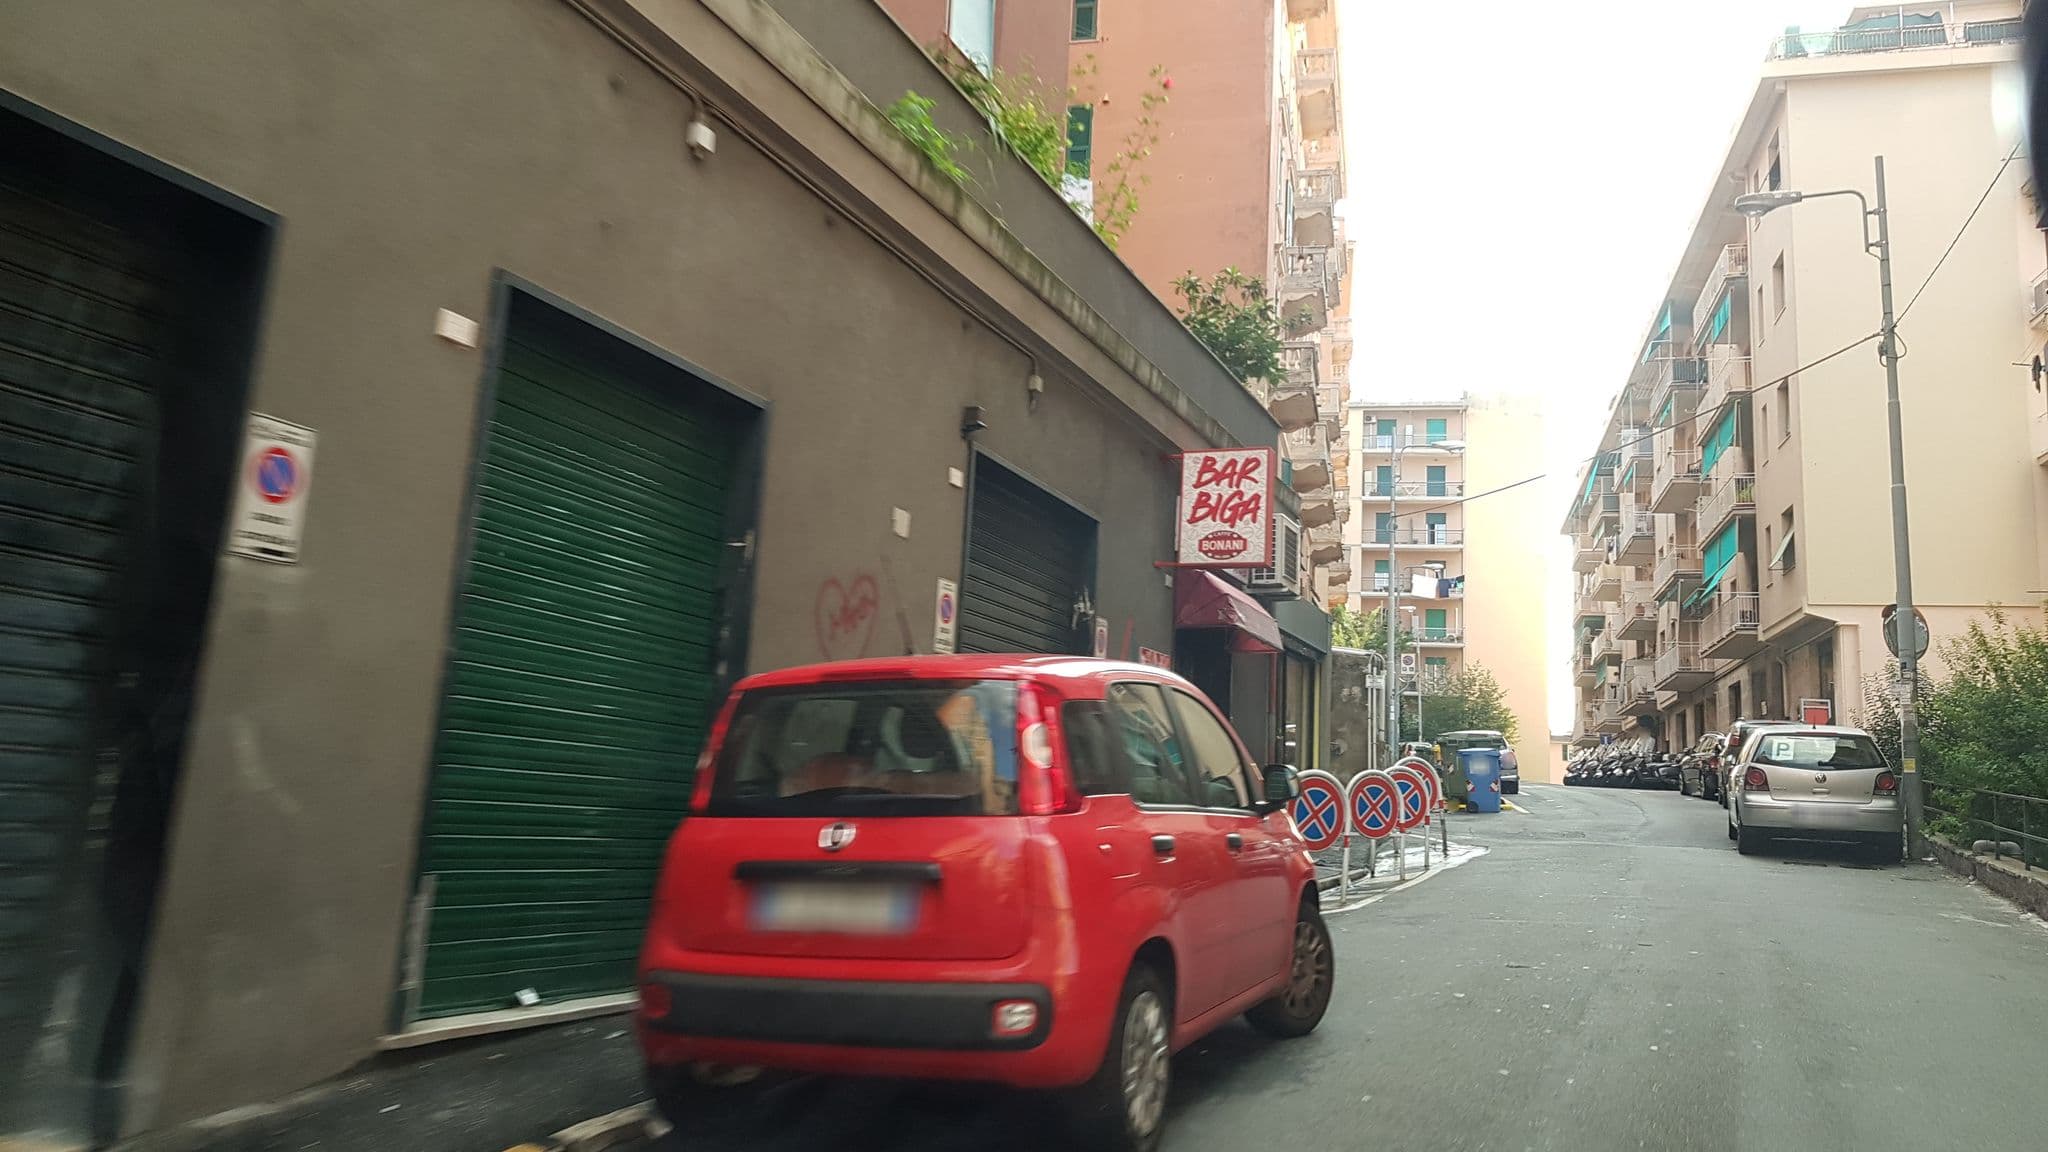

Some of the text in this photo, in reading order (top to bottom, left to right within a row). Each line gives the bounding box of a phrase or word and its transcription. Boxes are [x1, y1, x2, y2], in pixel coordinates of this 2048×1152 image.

[1192, 456, 1262, 489] BAR
[1187, 490, 1261, 528] BIGA
[1202, 540, 1244, 550] BONANI
[1777, 742, 1790, 756] P
